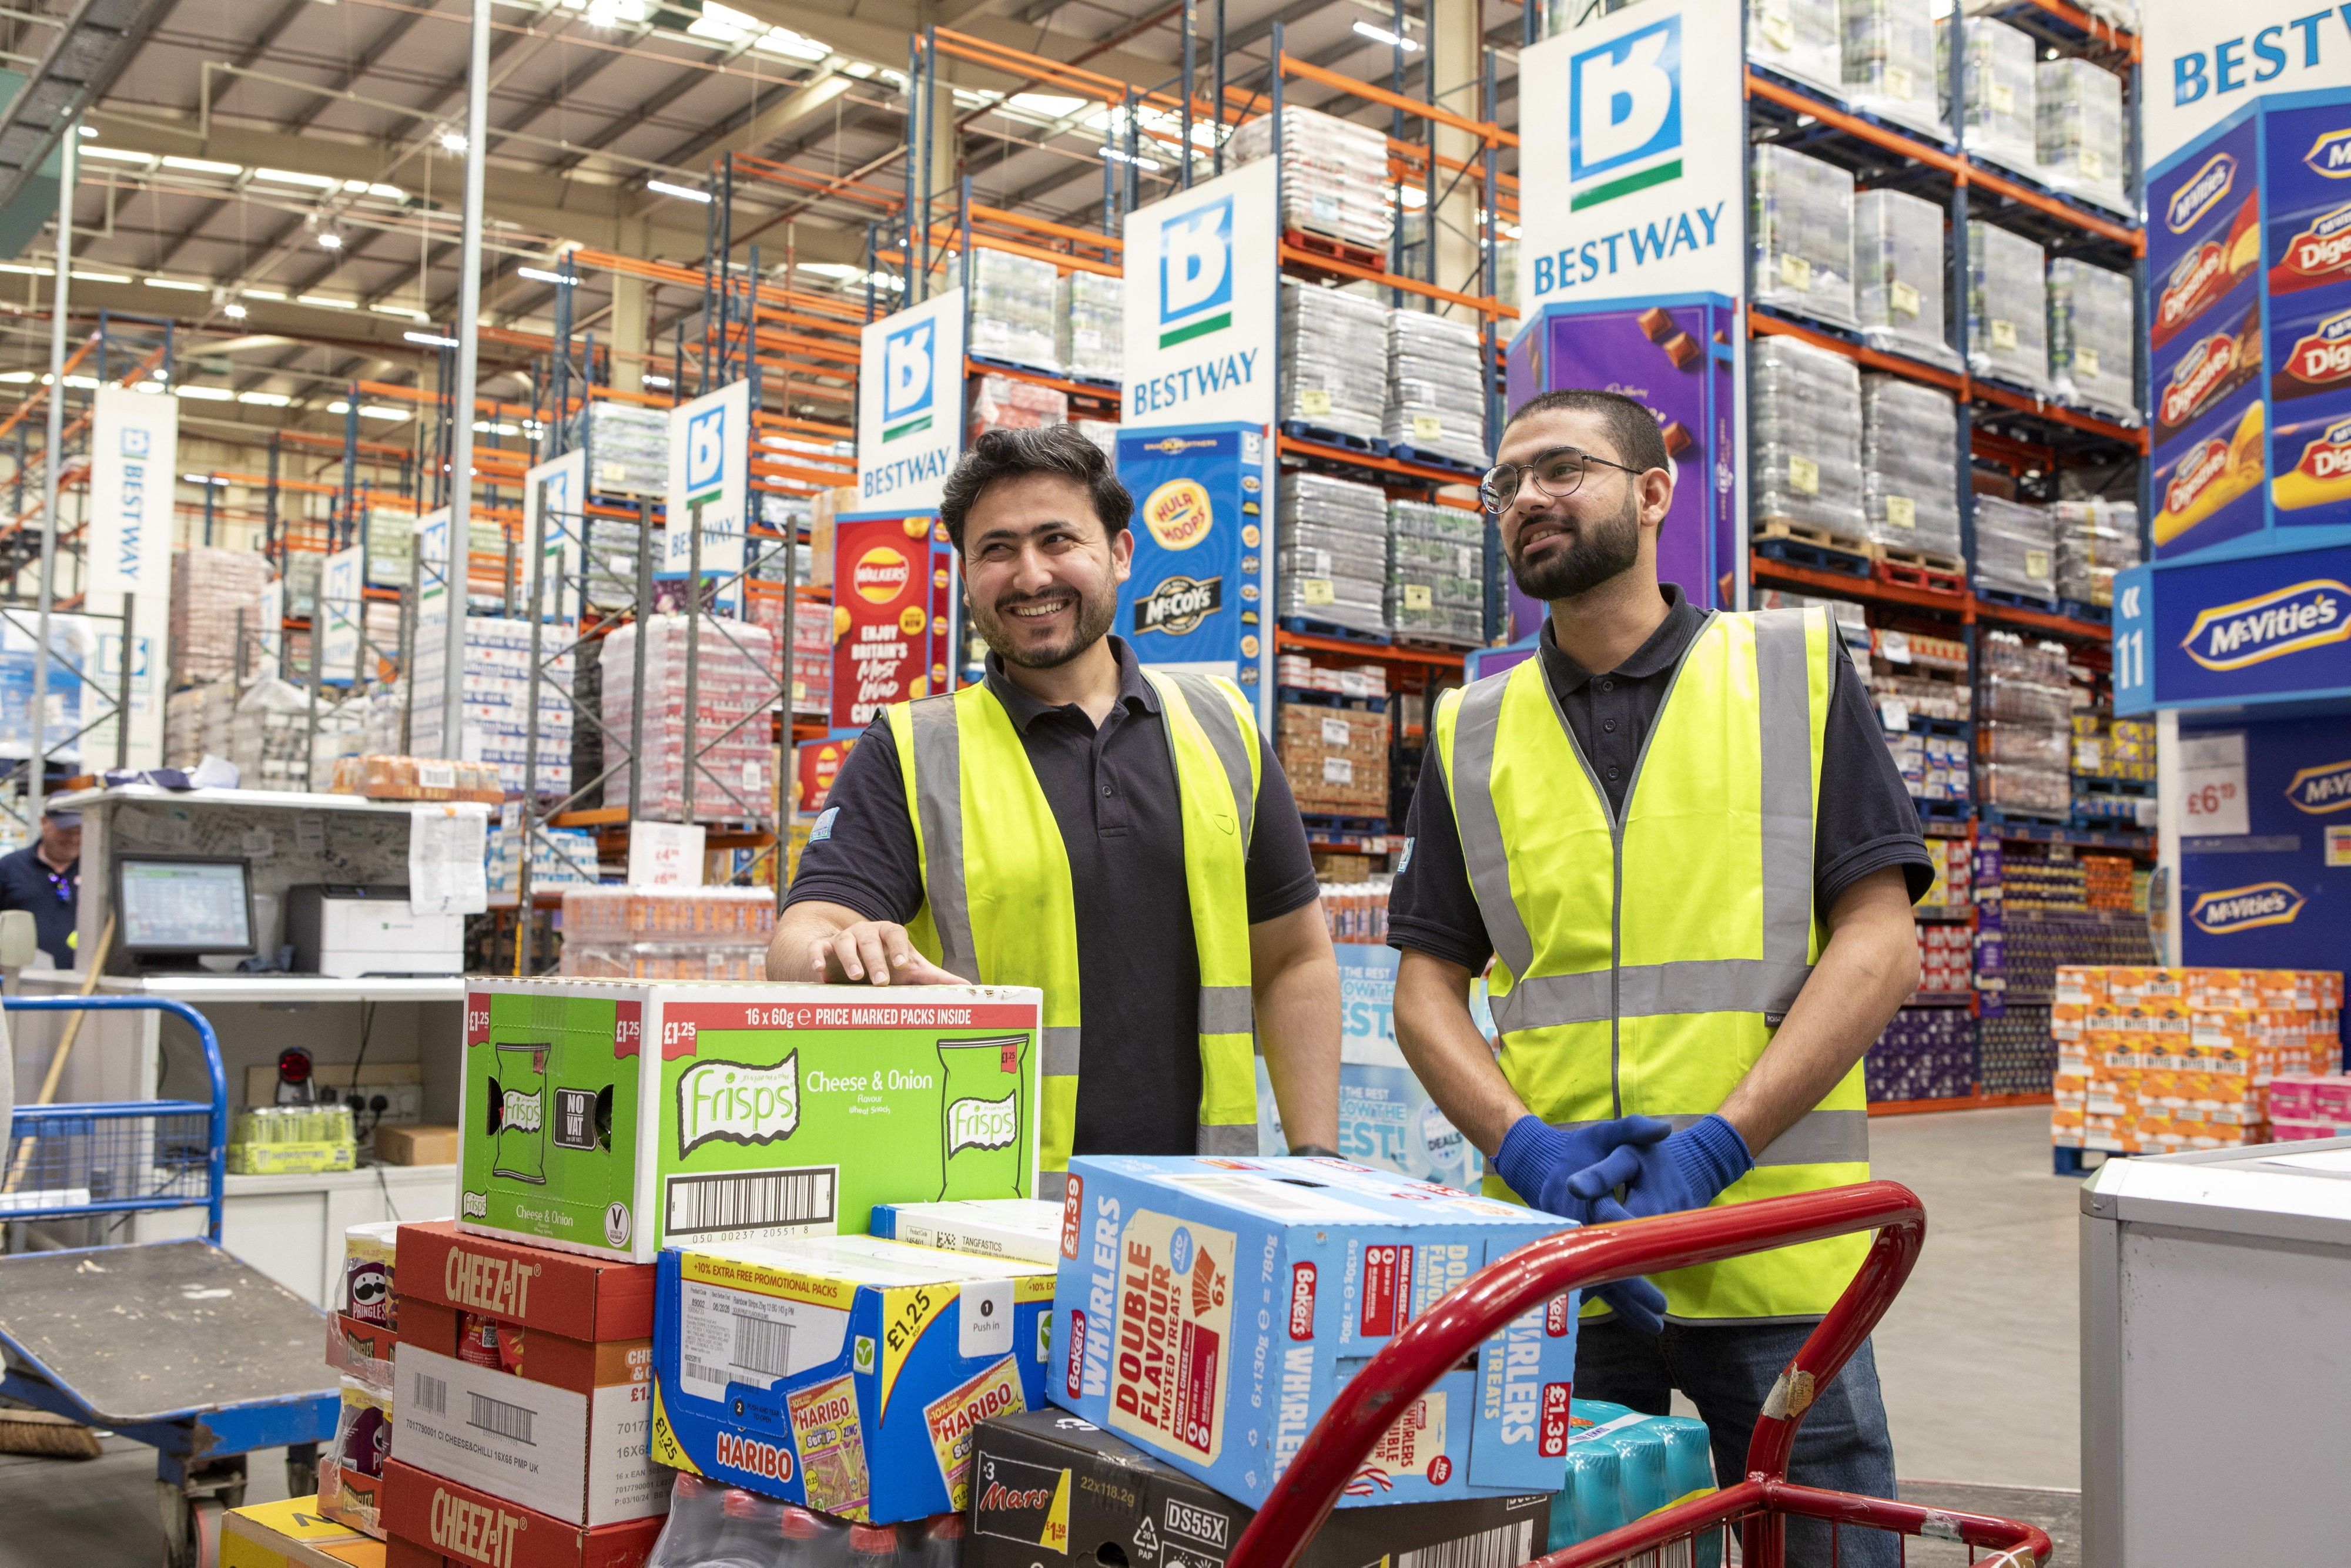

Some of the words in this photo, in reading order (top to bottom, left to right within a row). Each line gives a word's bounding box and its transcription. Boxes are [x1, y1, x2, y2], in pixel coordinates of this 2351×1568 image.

[2173, 4, 2351, 107] BEST
[1535, 202, 1725, 294] BESTWAY
[1134, 348, 1258, 415] BESTWAY
[865, 447, 950, 498] BESTWAY
[1156, 491, 1194, 522] HULA
[1160, 505, 1206, 542] HOOPS
[856, 566, 907, 583] WALKERS
[2210, 594, 2338, 656] McVitie's
[2116, 629, 2144, 690] 11
[1346, 967, 1362, 978] THE
[1366, 967, 1391, 979] REST
[470, 1011, 489, 1031] £1.25
[617, 1021, 639, 1043] £1.25
[664, 1022, 696, 1044] £1.25
[745, 1008, 759, 1025] 16
[762, 1012, 769, 1025] x
[771, 1008, 794, 1028] 60g
[815, 1008, 849, 1025] PRICE
[852, 1008, 898, 1025] MARKED
[900, 1008, 935, 1025] PACKS
[937, 1008, 972, 1024] INSIDE
[806, 1070, 867, 1093] Cheese
[872, 1071, 883, 1090] &
[888, 1069, 932, 1090] Onion
[1346, 1088, 1362, 1099] THE
[1366, 1088, 1390, 1099] REST
[567, 1094, 584, 1113] NO
[567, 1116, 584, 1136] VAT
[1428, 1132, 1463, 1151] DEALS
[517, 1205, 542, 1221] Cheese
[544, 1212, 550, 1223] &
[552, 1211, 573, 1227] Onion
[1064, 1178, 1080, 1257] £1.39
[692, 1234, 712, 1244] 050
[721, 1231, 755, 1241] 00237
[763, 1227, 795, 1238] 20551
[803, 1226, 809, 1234] 8
[962, 1235, 1002, 1252] TANGFASTICS
[694, 1263, 711, 1275] +10%
[712, 1265, 735, 1279] EXTRA
[736, 1269, 752, 1282] FREE
[755, 1273, 811, 1294] PROMOTIONAL
[812, 1284, 838, 1298] PACKS
[1029, 1281, 1045, 1292] +10%
[1426, 1245, 1446, 1308] FLAVO
[353, 1302, 387, 1321] PRINGLES
[691, 1298, 705, 1309] 89002
[1083, 1195, 1120, 1396] WHIRLERS
[1292, 1268, 1314, 1334] Bakers
[887, 1289, 931, 1352] £1.25
[973, 1322, 990, 1332] Push
[992, 1321, 1000, 1331] in
[1117, 1241, 1152, 1418] DOUBLE
[1168, 1285, 1181, 1349] TREATS
[1069, 1316, 1085, 1391] Bakers
[1140, 1264, 1171, 1428] FLAVOUR
[1160, 1354, 1177, 1432] TWISTED
[1485, 1347, 1505, 1420] TREATS
[1501, 1306, 1543, 1445] HIRLERS
[631, 1388, 650, 1402] £1.
[798, 1396, 850, 1430] HARIBO
[940, 1383, 1013, 1443] HARIBO
[1545, 1385, 1567, 1455] £1.39
[445, 1433, 493, 1459] CHEESE&CHILLI
[514, 1454, 528, 1469] PMP
[529, 1461, 538, 1475] UK
[655, 1416, 678, 1461] £1.25
[1387, 1426, 1400, 1462] UBLE
[718, 1432, 792, 1482] HARIBO
[615, 1482, 654, 1494] 7017790001
[980, 1481, 1049, 1512] Mars
[1080, 1476, 1135, 1508] 22x118.2g
[1168, 1503, 1225, 1543] DS55X
[1138, 1549, 1153, 1560] PAP
